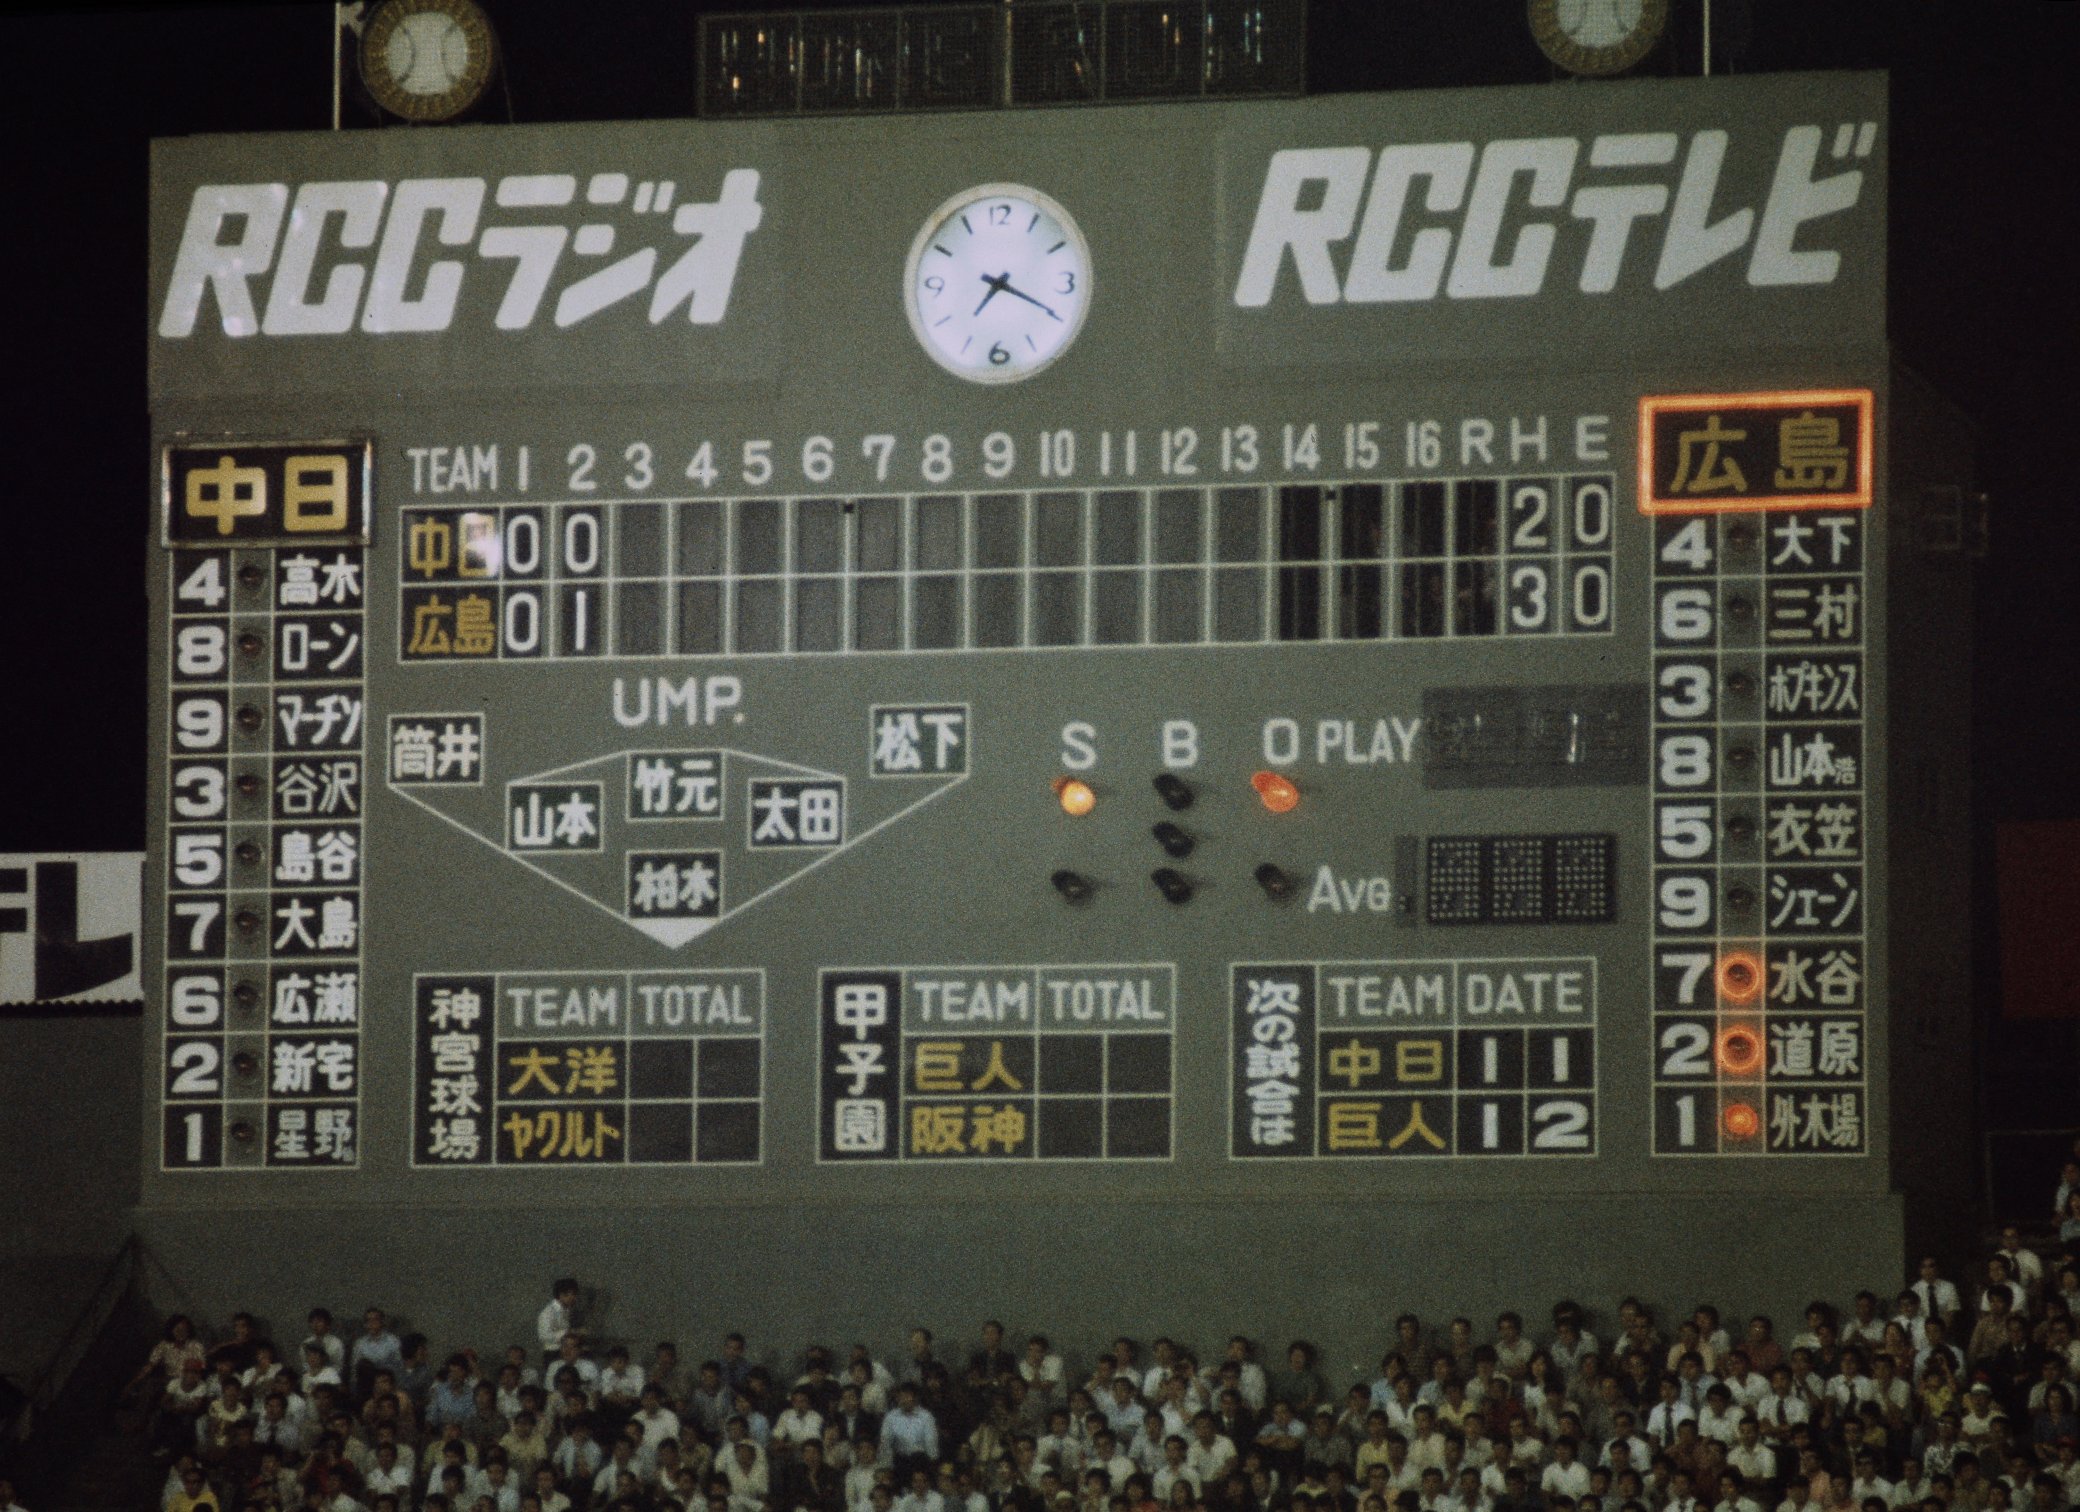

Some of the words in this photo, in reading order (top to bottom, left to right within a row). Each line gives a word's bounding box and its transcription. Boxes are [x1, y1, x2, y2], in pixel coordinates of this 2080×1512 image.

[989, 204, 1011, 225] 12
[1234, 122, 1878, 306] RCCテレビ
[159, 168, 763, 338] RCCラジオ
[924, 276, 945, 297] 9
[1055, 272, 1075, 294] 3
[988, 341, 1010, 365] 6
[407, 444, 497, 494] TEAM
[518, 446, 529, 492] 1
[567, 444, 597, 491] 2
[624, 442, 653, 490] 3
[685, 441, 718, 487] 4
[743, 440, 773, 485] 5
[803, 436, 833, 481] 6
[862, 434, 896, 480] 7
[923, 434, 953, 482] 8
[983, 432, 1014, 478] 9
[1040, 429, 1075, 477] 10
[1101, 430, 1136, 476] 11
[1162, 428, 1198, 476] 12
[1222, 425, 1259, 473] 13
[1284, 423, 1320, 471] 14
[1344, 422, 1379, 470] 15
[1407, 421, 1441, 469] 16
[1461, 420, 1494, 466] R
[1510, 417, 1548, 462] H
[1576, 416, 1610, 460] E
[1669, 412, 1849, 492] 広島
[186, 455, 348, 535] 中日
[409, 512, 496, 578] 中日
[507, 515, 539, 573] 0
[565, 514, 597, 572] 0
[1512, 487, 1548, 547] 2
[1575, 484, 1609, 544] 0
[1661, 519, 1713, 569] 4
[1772, 515, 1856, 565] 大下
[178, 558, 225, 605] 4
[279, 553, 360, 605] 高木
[408, 594, 495, 653] 広島
[505, 592, 538, 652] 0
[575, 591, 586, 650] 1
[1511, 567, 1547, 627] 3
[1574, 565, 1608, 626] 0
[1661, 589, 1712, 639] 6
[1769, 583, 1857, 639] 三村
[177, 626, 225, 674] 8
[282, 622, 359, 670] ローン
[612, 675, 743, 727] UMP.
[1660, 665, 1711, 717] 3
[1769, 661, 1858, 713] ホプキンス
[176, 698, 223, 747] 9
[876, 714, 963, 772] 松下
[1061, 721, 1096, 770] S
[1162, 720, 1199, 768] B
[1263, 718, 1299, 766] O
[1317, 717, 1421, 765] PLAY
[393, 724, 479, 780] 筒井
[1660, 735, 1711, 787] 8
[1771, 732, 1857, 786] 山本浩
[174, 766, 225, 817] 3
[276, 762, 357, 814] 谷沢
[634, 760, 717, 812] 竹元
[514, 792, 597, 847] 山本
[754, 788, 839, 843] 太田
[1660, 806, 1712, 858] 5
[1768, 803, 1858, 856] 衣笠
[174, 834, 223, 886] 5
[275, 830, 357, 882] 島谷
[634, 860, 716, 912] 柏木
[1660, 877, 1710, 928] 9
[174, 902, 221, 952] 7
[274, 897, 357, 950] 大島
[172, 975, 221, 1026] 6
[273, 972, 357, 1023] 広瀬
[915, 980, 1028, 1022] TEAM
[1048, 980, 1165, 1021] TOTAL
[1328, 975, 1444, 1017] TEAM
[1466, 972, 1583, 1015] DATE
[1662, 953, 1711, 1004] 7
[1770, 950, 1860, 1004] 水谷
[506, 987, 617, 1028] TEAM
[639, 984, 752, 1026] TOTAL
[171, 1042, 219, 1094] 2
[273, 1041, 354, 1093] 新宅
[428, 987, 481, 1159] 神宮球場
[509, 1047, 618, 1095] 大洋
[835, 984, 887, 1152] 甲子園
[914, 1041, 1022, 1090] 巨人
[1329, 1039, 1444, 1087] 中日
[1662, 1022, 1710, 1075] 2
[1769, 1020, 1860, 1076] 道原
[183, 1113, 203, 1162] 1
[503, 1110, 620, 1158] ヤクルト
[911, 1104, 1026, 1153] 阪神
[1328, 1100, 1446, 1150] 巨人
[1676, 1095, 1696, 1147] 1
[1770, 1093, 1860, 1147] 外木場
